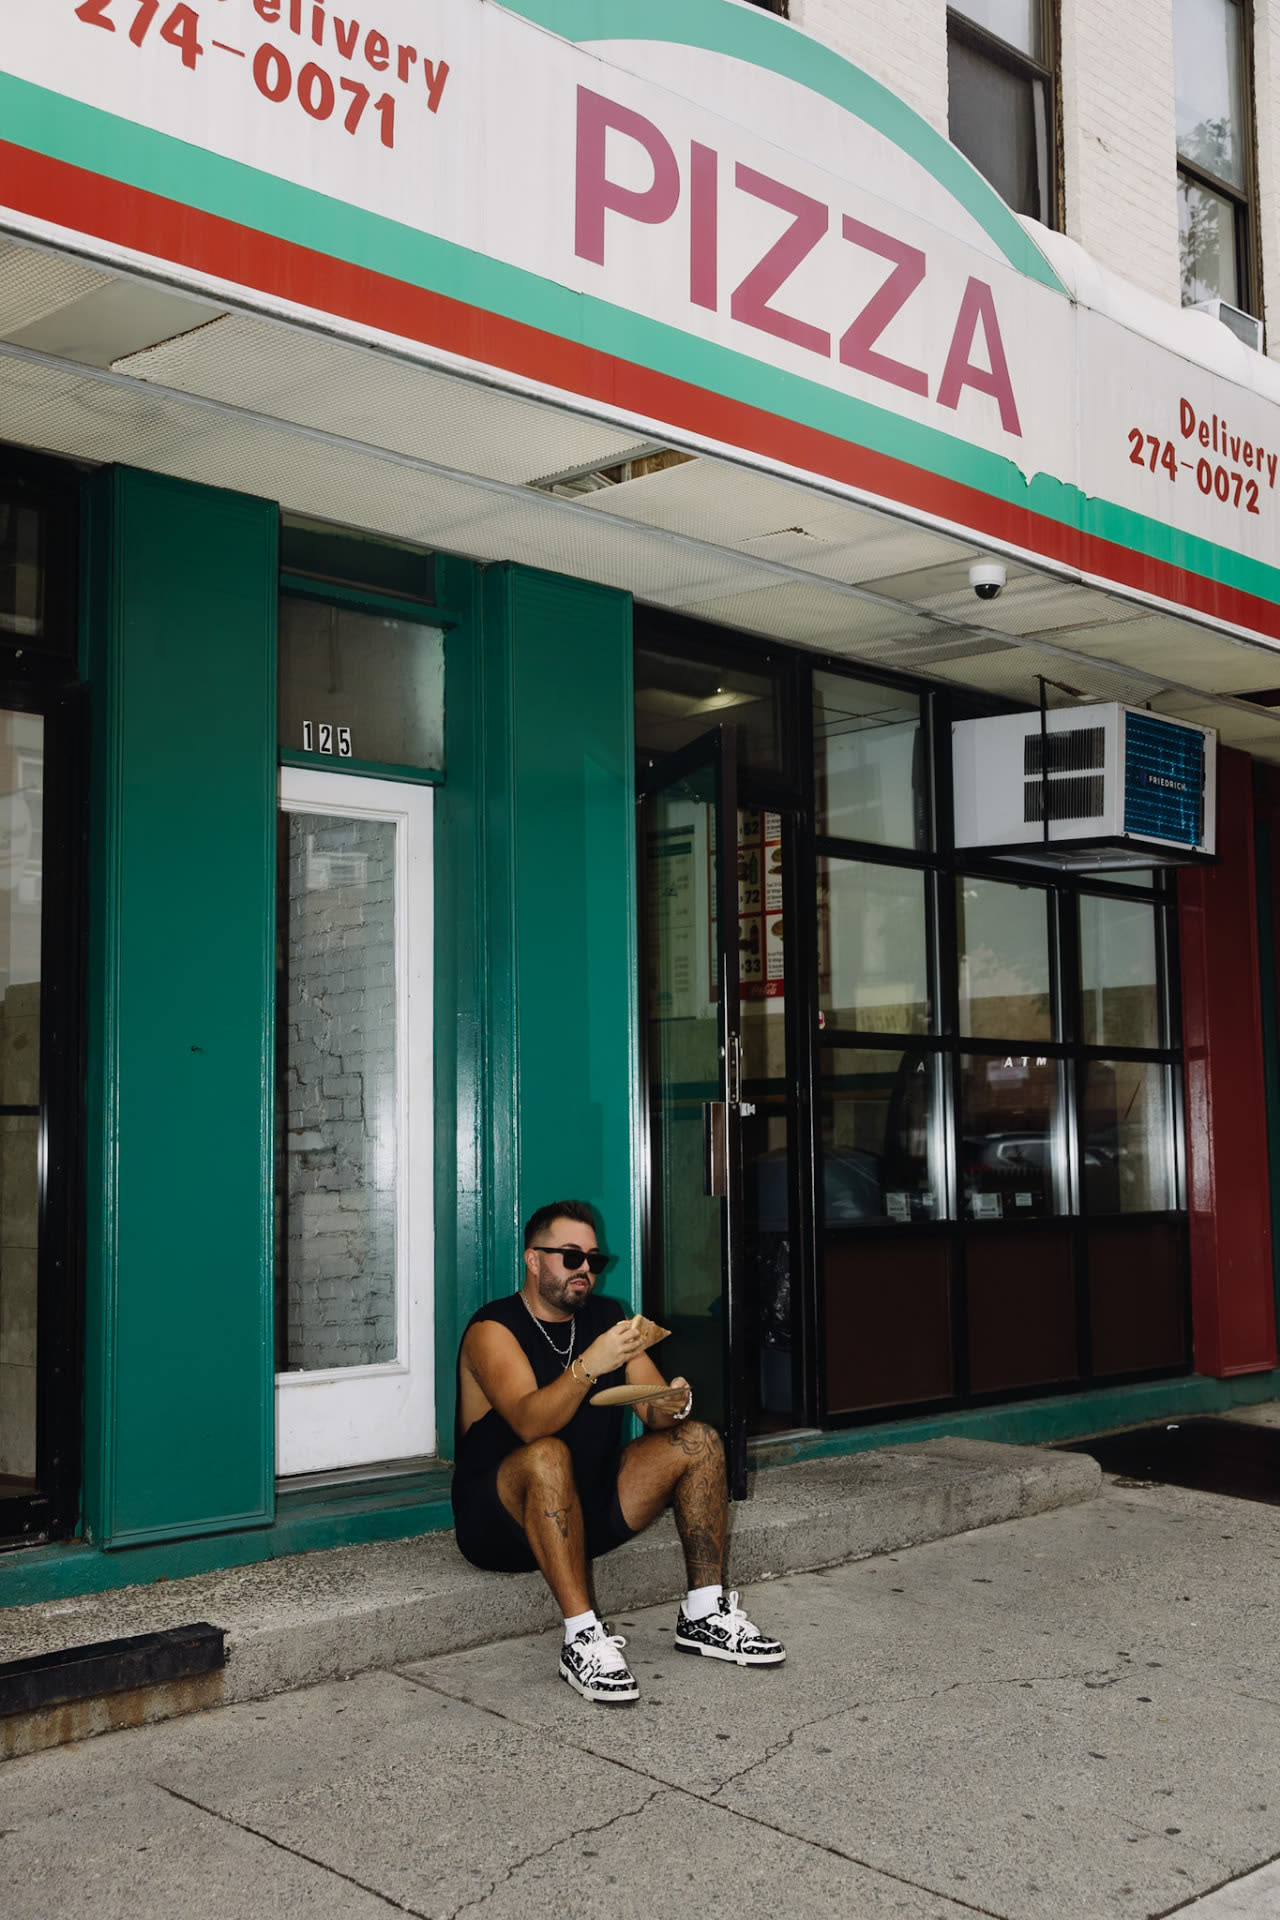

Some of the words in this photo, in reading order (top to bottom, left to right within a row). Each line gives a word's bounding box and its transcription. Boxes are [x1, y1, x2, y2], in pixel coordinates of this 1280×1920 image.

[217, 0, 449, 114] elivery
[574, 84, 1022, 438] PIZZA
[1128, 428, 1260, 515] 274-0072
[1180, 397, 1278, 489] Delivery
[303, 722, 351, 756] 125
[1148, 775, 1187, 791] FRIEDRICH
[1003, 1056, 1048, 1068] ATM
